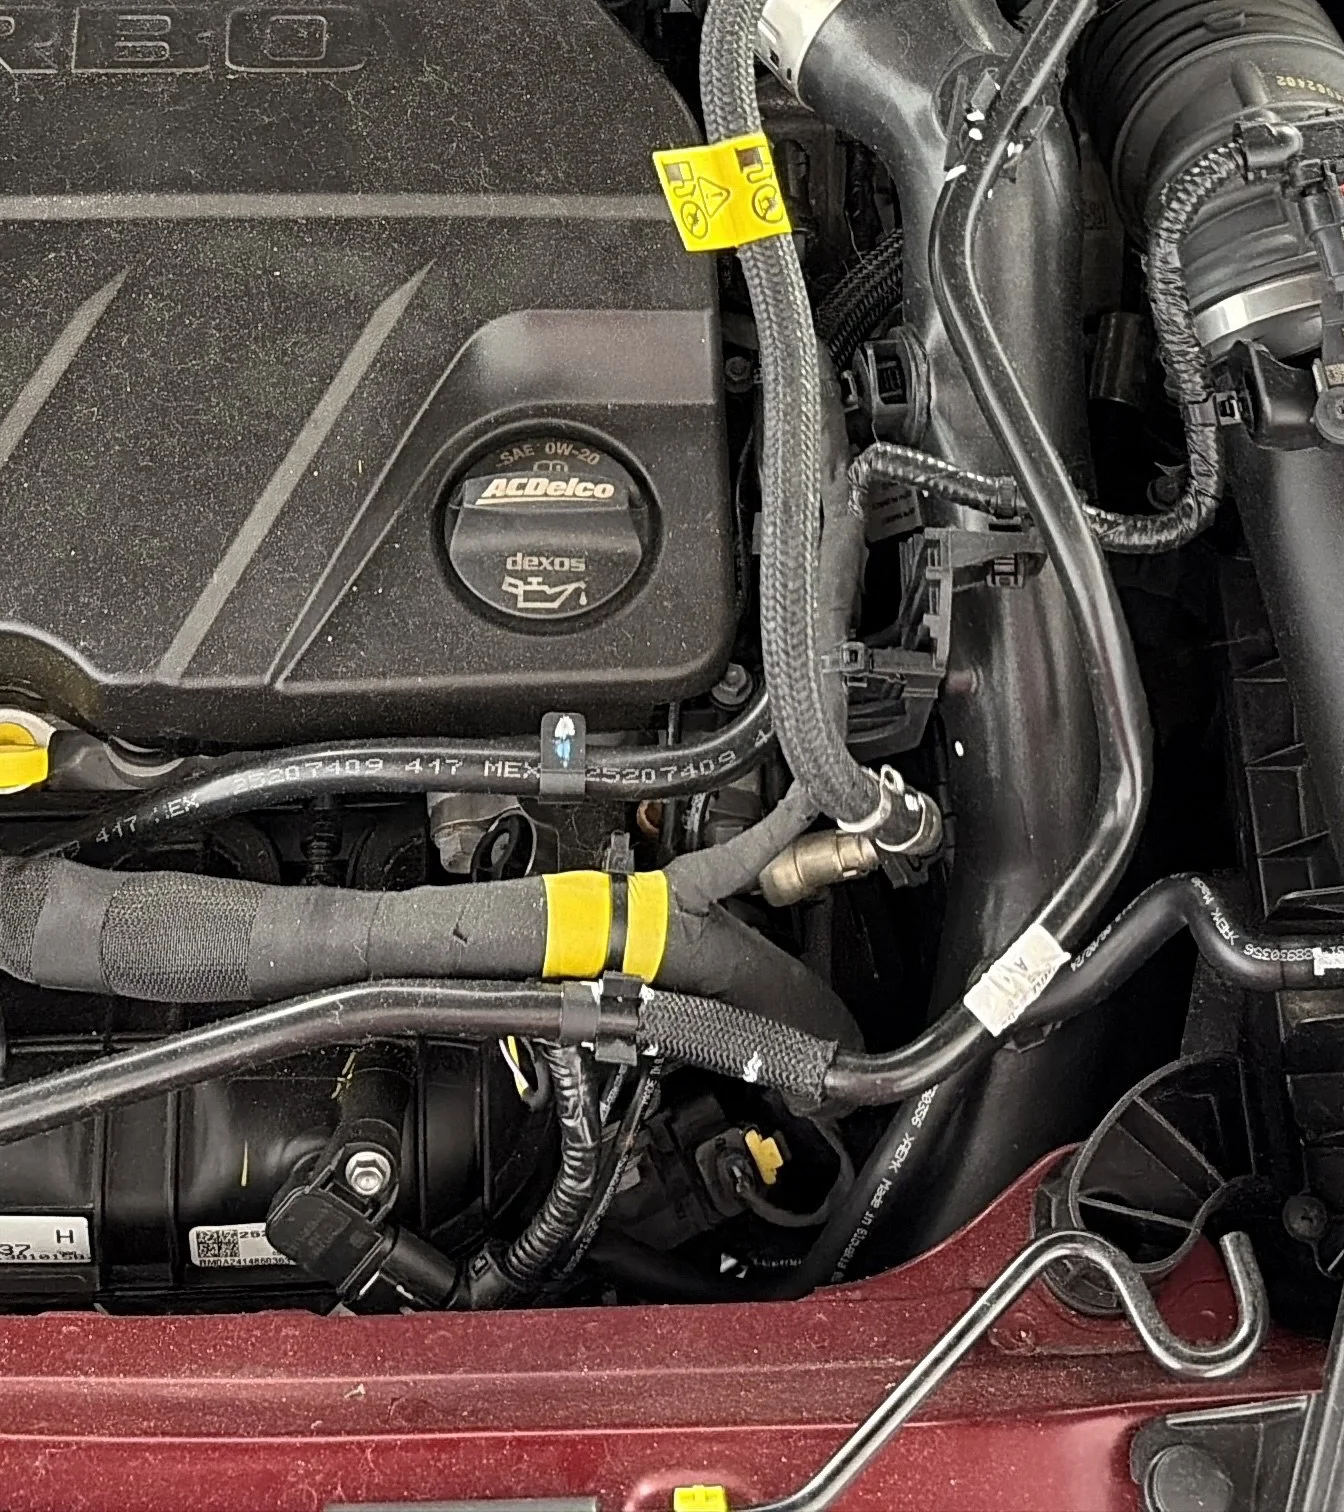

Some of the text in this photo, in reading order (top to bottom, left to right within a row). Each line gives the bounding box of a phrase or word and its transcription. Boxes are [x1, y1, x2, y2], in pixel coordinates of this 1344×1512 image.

[500, 442, 601, 466] SAE 0W-20
[481, 477, 615, 500] ACDelco
[506, 552, 586, 571] dexos
[96, 815, 137, 843] 417
[405, 759, 464, 777] 417
[484, 760, 542, 779] MEX
[870, 1177, 893, 1209] Made
[56, 1229, 74, 1244] H
